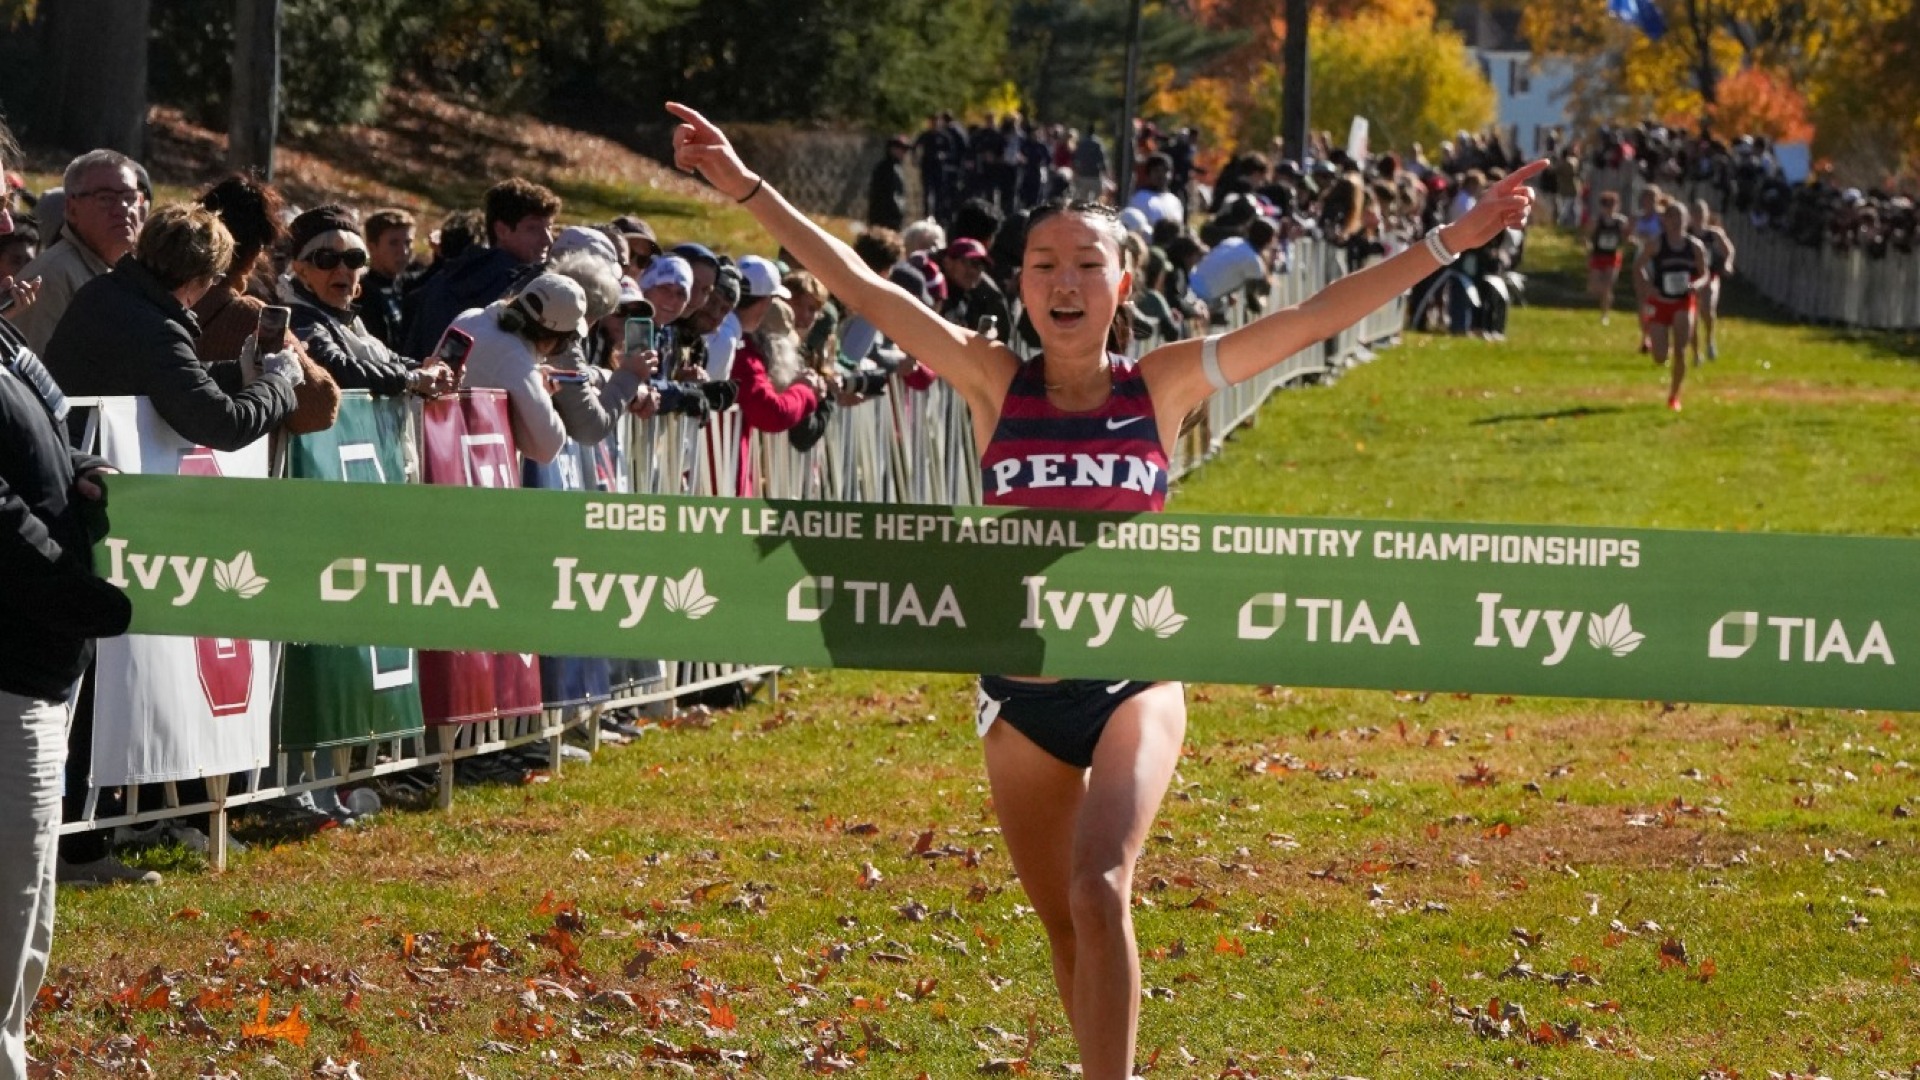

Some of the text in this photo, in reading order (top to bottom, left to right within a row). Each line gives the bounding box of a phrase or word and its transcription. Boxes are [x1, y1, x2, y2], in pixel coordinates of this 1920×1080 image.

[993, 453, 1159, 497] PENN
[585, 501, 1641, 569] 2026 IVY LEAGUE HEPTAGONAL CROSS COUNTRY CHAMPIONSHIPS
[105, 537, 208, 607] Ivy
[376, 562, 499, 609] TIAA
[552, 556, 659, 628] Ivy
[844, 580, 966, 628] TIAA
[1020, 573, 1127, 648] Ivy
[1295, 596, 1420, 647] TIAA
[1474, 591, 1585, 666] Ivy
[1767, 615, 1895, 667] TIAA
